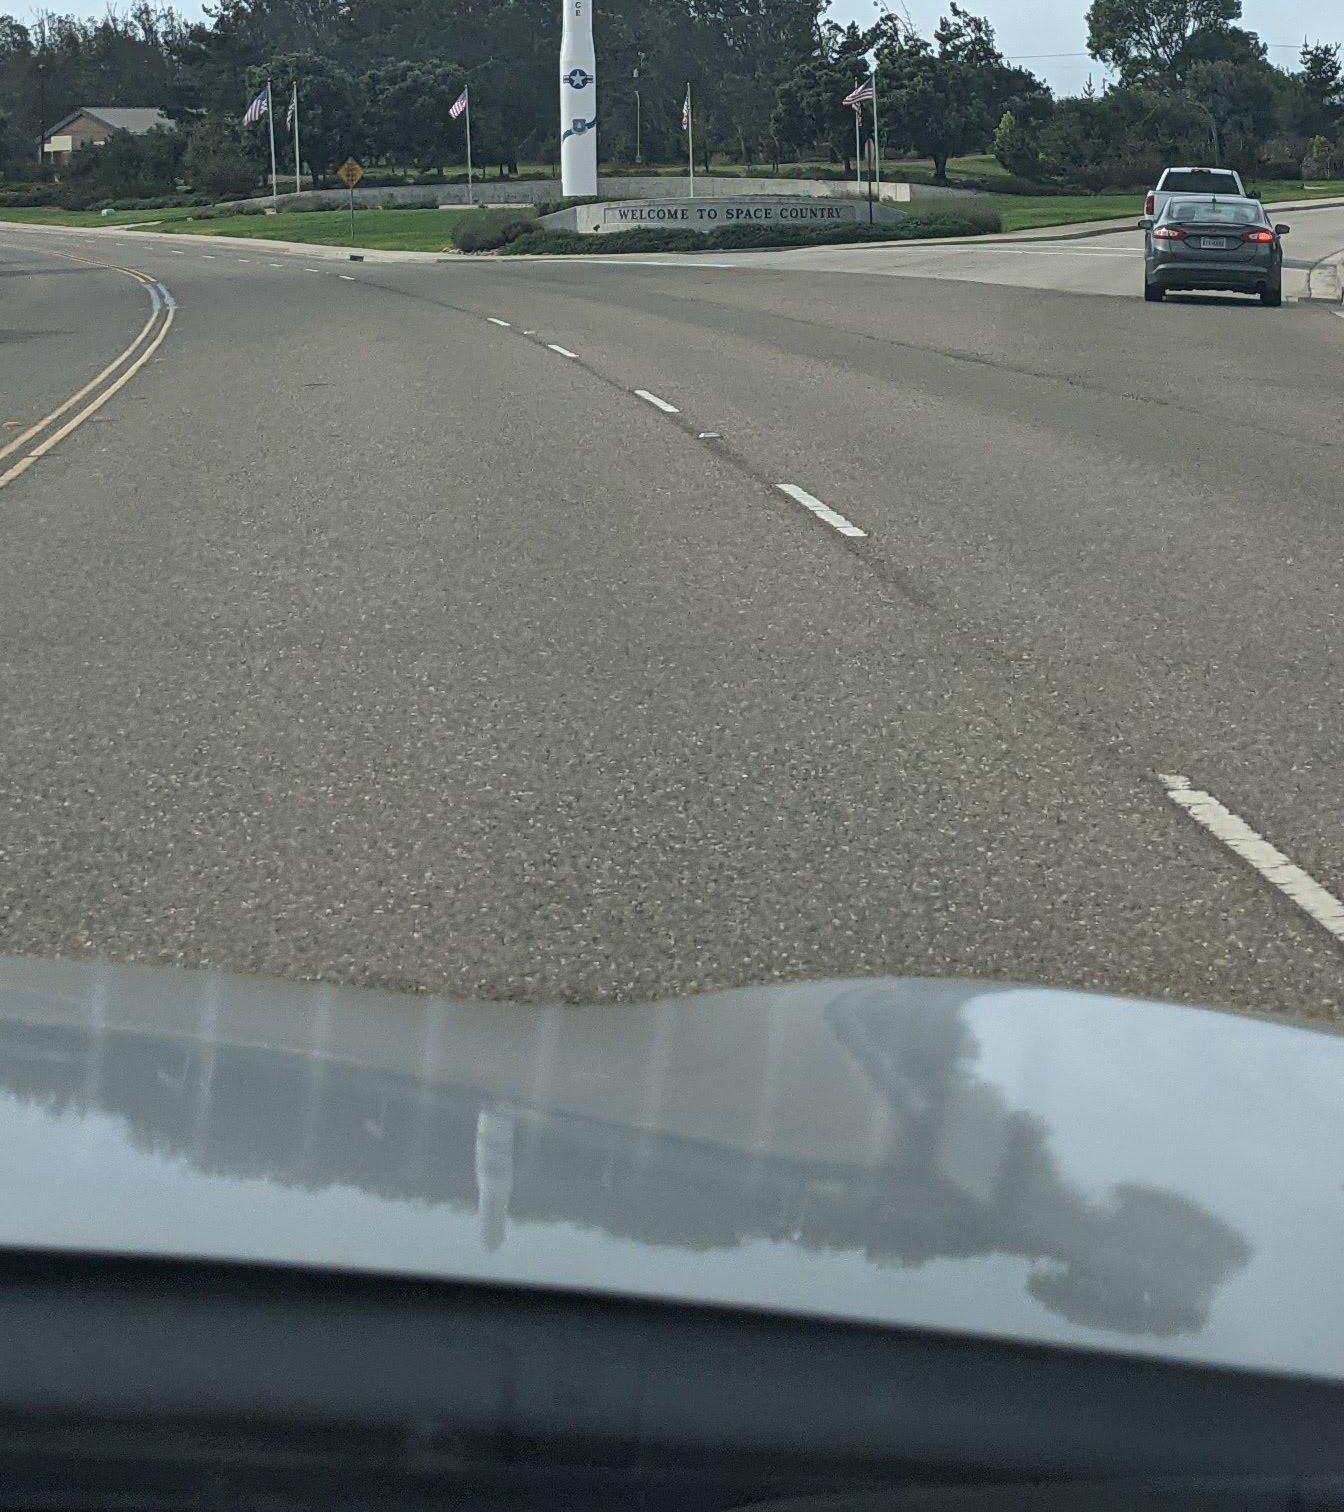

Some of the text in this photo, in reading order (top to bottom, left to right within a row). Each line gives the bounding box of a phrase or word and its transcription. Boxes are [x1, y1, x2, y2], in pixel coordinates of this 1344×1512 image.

[618, 207, 843, 220] WELCOME TO SPACE COUNTRY
